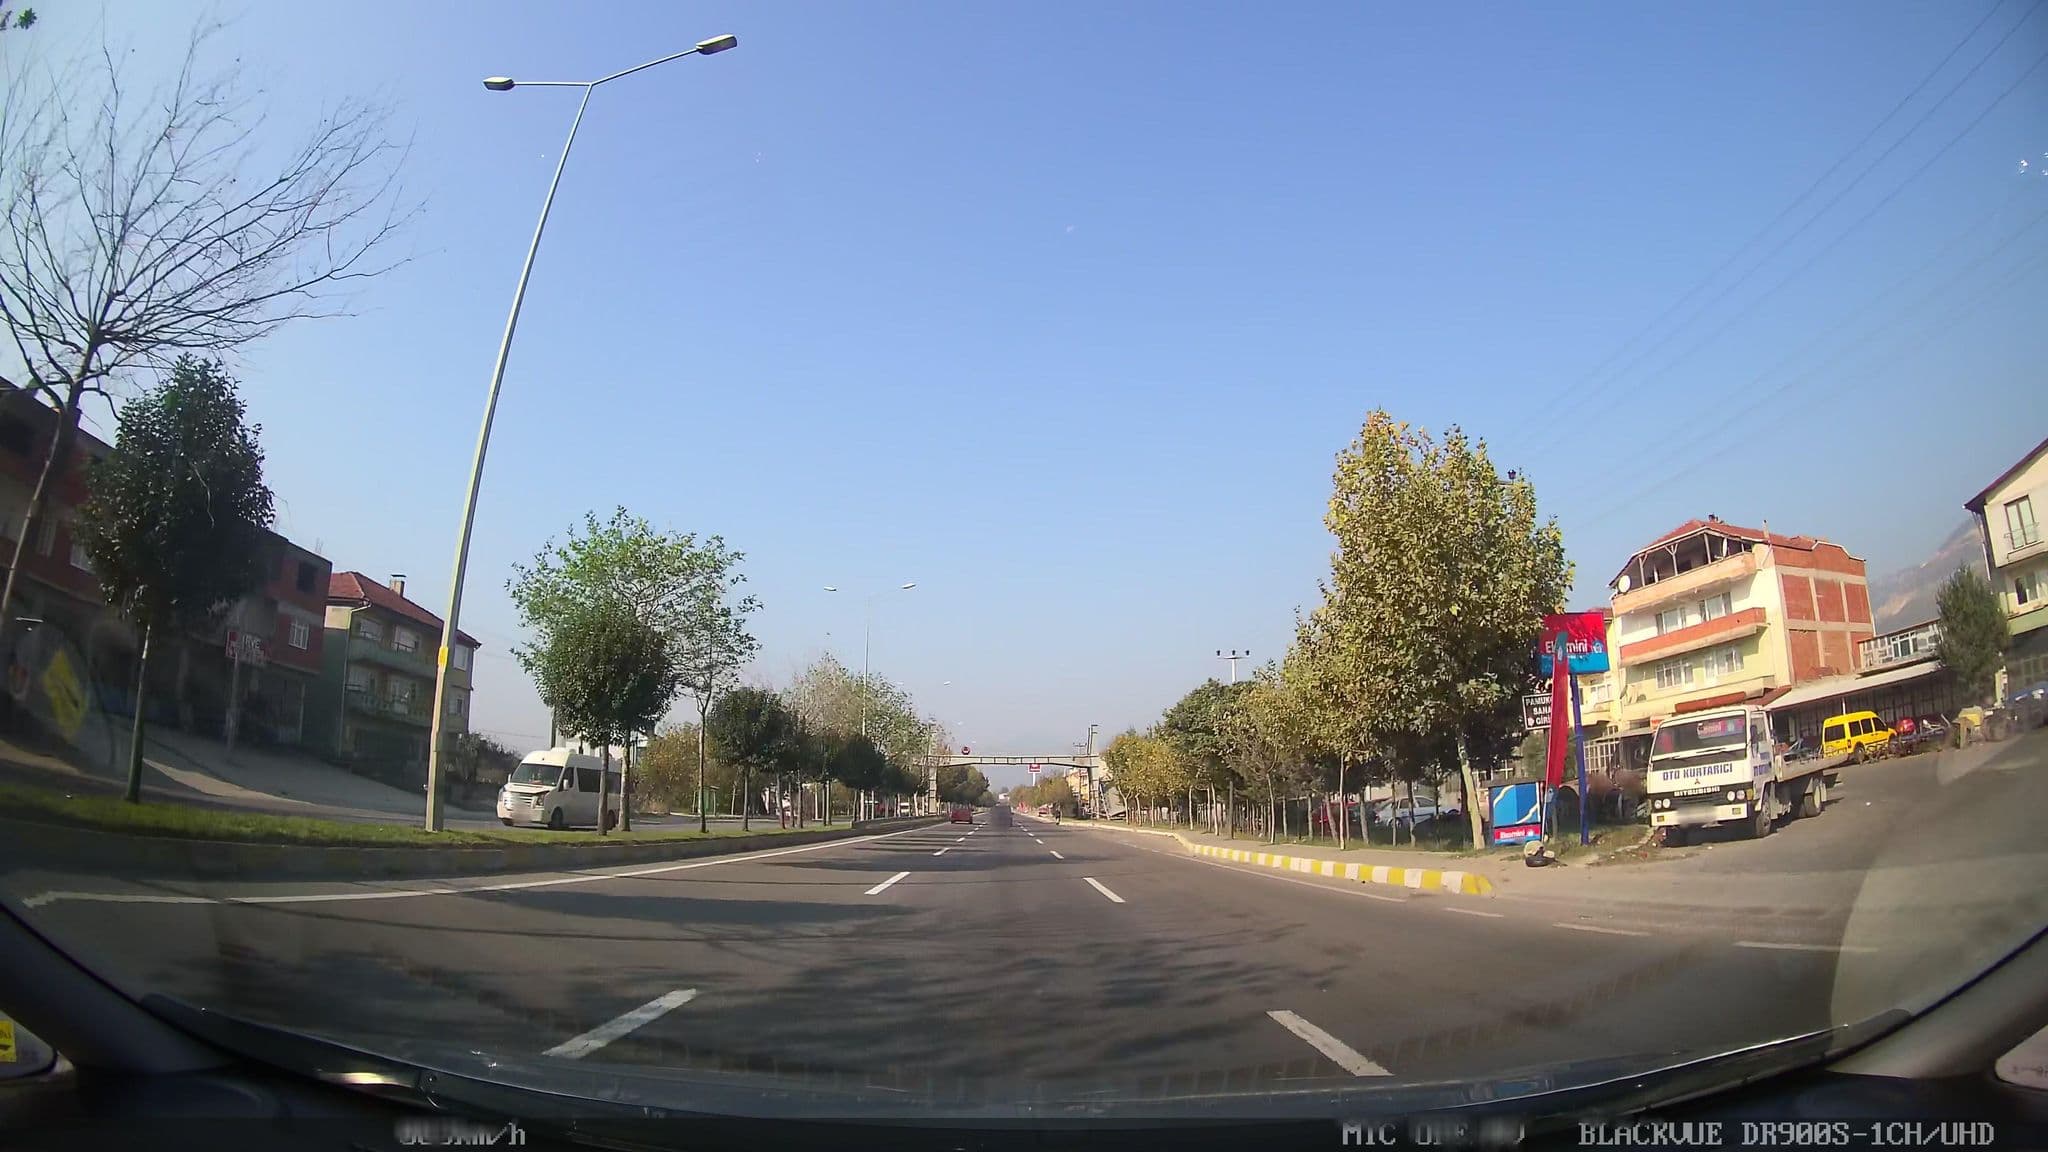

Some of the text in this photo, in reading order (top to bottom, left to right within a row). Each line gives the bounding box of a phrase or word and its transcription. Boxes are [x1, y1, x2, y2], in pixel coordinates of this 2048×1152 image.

[1545, 640, 1588, 653] Ekmini
[1525, 697, 1553, 706] PAMUK
[1663, 763, 1733, 781] OTO KURTARICI
[1674, 786, 1720, 797] MITSUBISHI
